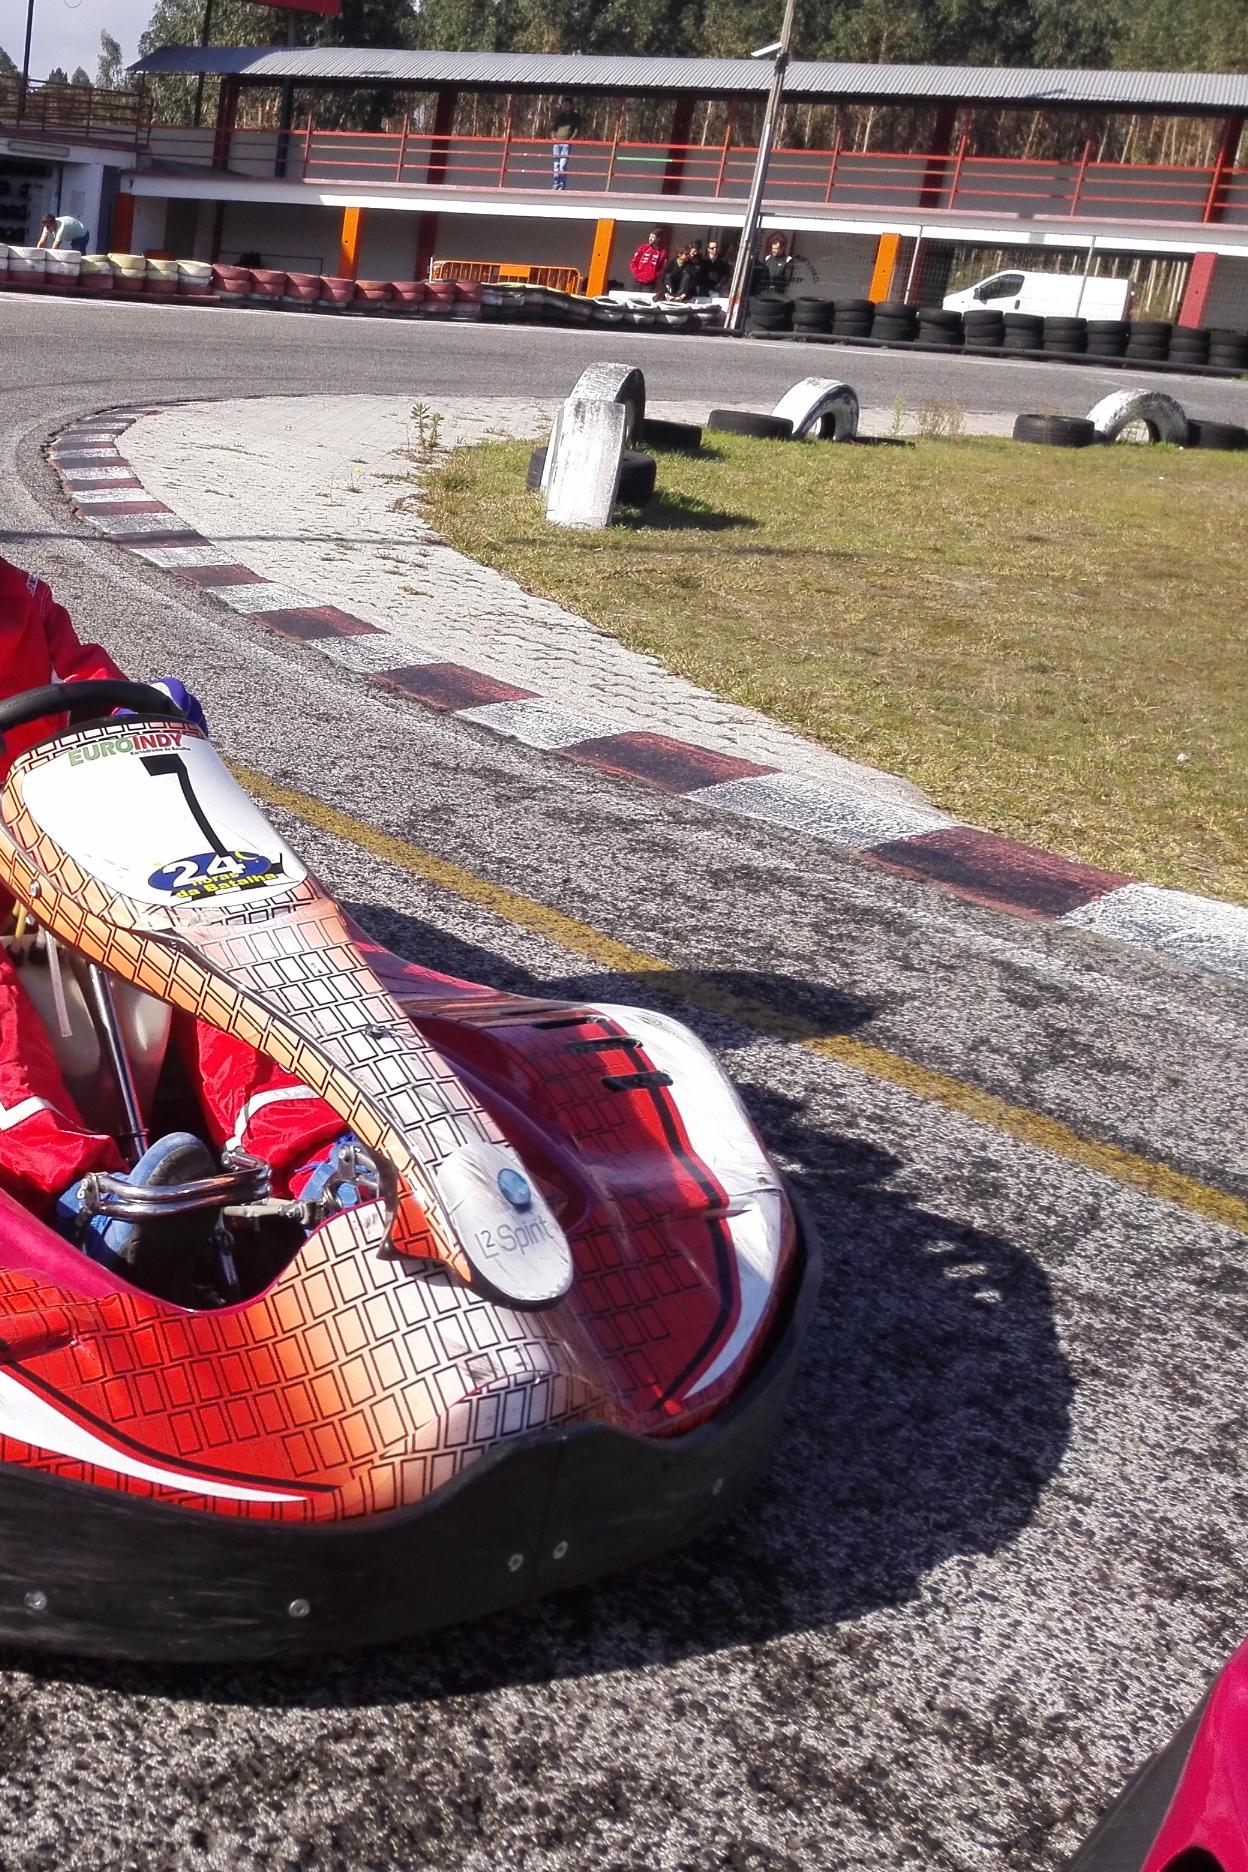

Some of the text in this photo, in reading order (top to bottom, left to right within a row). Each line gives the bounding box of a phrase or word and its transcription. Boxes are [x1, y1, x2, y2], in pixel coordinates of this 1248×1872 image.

[68, 732, 183, 767] EUROINDY
[139, 752, 230, 858] 7
[162, 854, 247, 888] 24
[175, 872, 278, 899] da Batalha
[192, 872, 240, 887] horas
